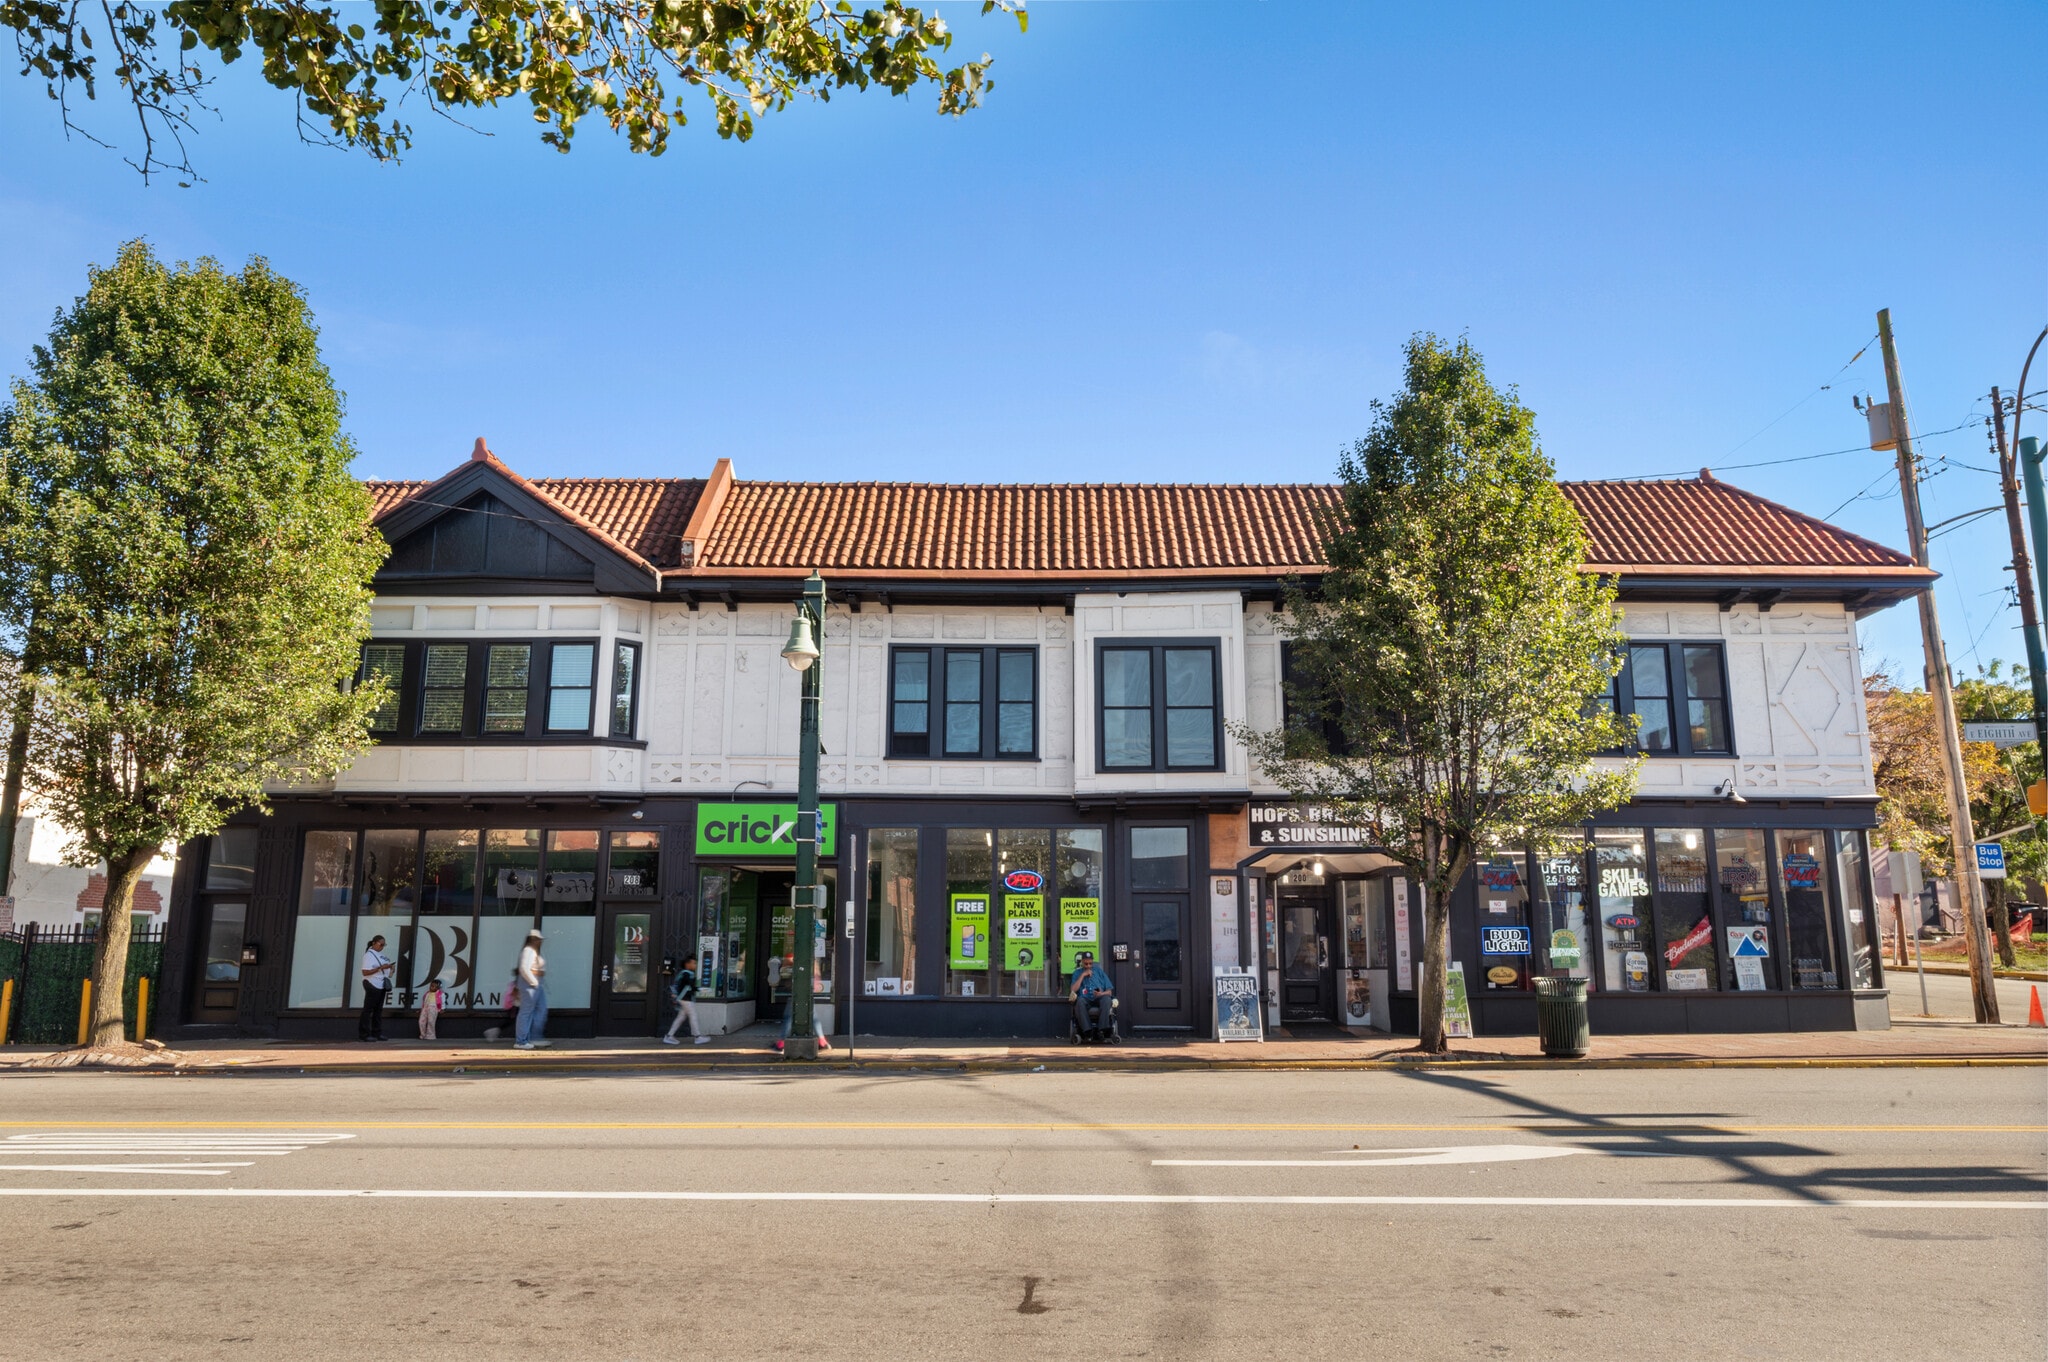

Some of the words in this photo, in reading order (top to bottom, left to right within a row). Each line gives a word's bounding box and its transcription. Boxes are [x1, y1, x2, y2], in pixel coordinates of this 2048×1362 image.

[1978, 729, 2015, 738] EIGHTH
[1260, 829, 1275, 842] &
[1979, 847, 1999, 856] Bus
[1978, 856, 2003, 867] Stop
[1541, 865, 1581, 874] ULTRA
[1783, 867, 1821, 881] Chill
[624, 875, 640, 885] 208
[1008, 873, 1040, 888] OPEN
[1602, 868, 1644, 884] SKILL
[1598, 881, 1650, 898] GAMES
[956, 901, 985, 913] FREE
[1008, 910, 1041, 918] PLANS!
[1012, 922, 1033, 933] $25
[1616, 917, 1637, 926] ATM
[1068, 925, 1089, 937] $25
[1489, 929, 1522, 941] BUD
[1484, 940, 1528, 952] LIGHT
[1664, 924, 1713, 962] Budweiser
[1216, 979, 1257, 996] ARSENAL
